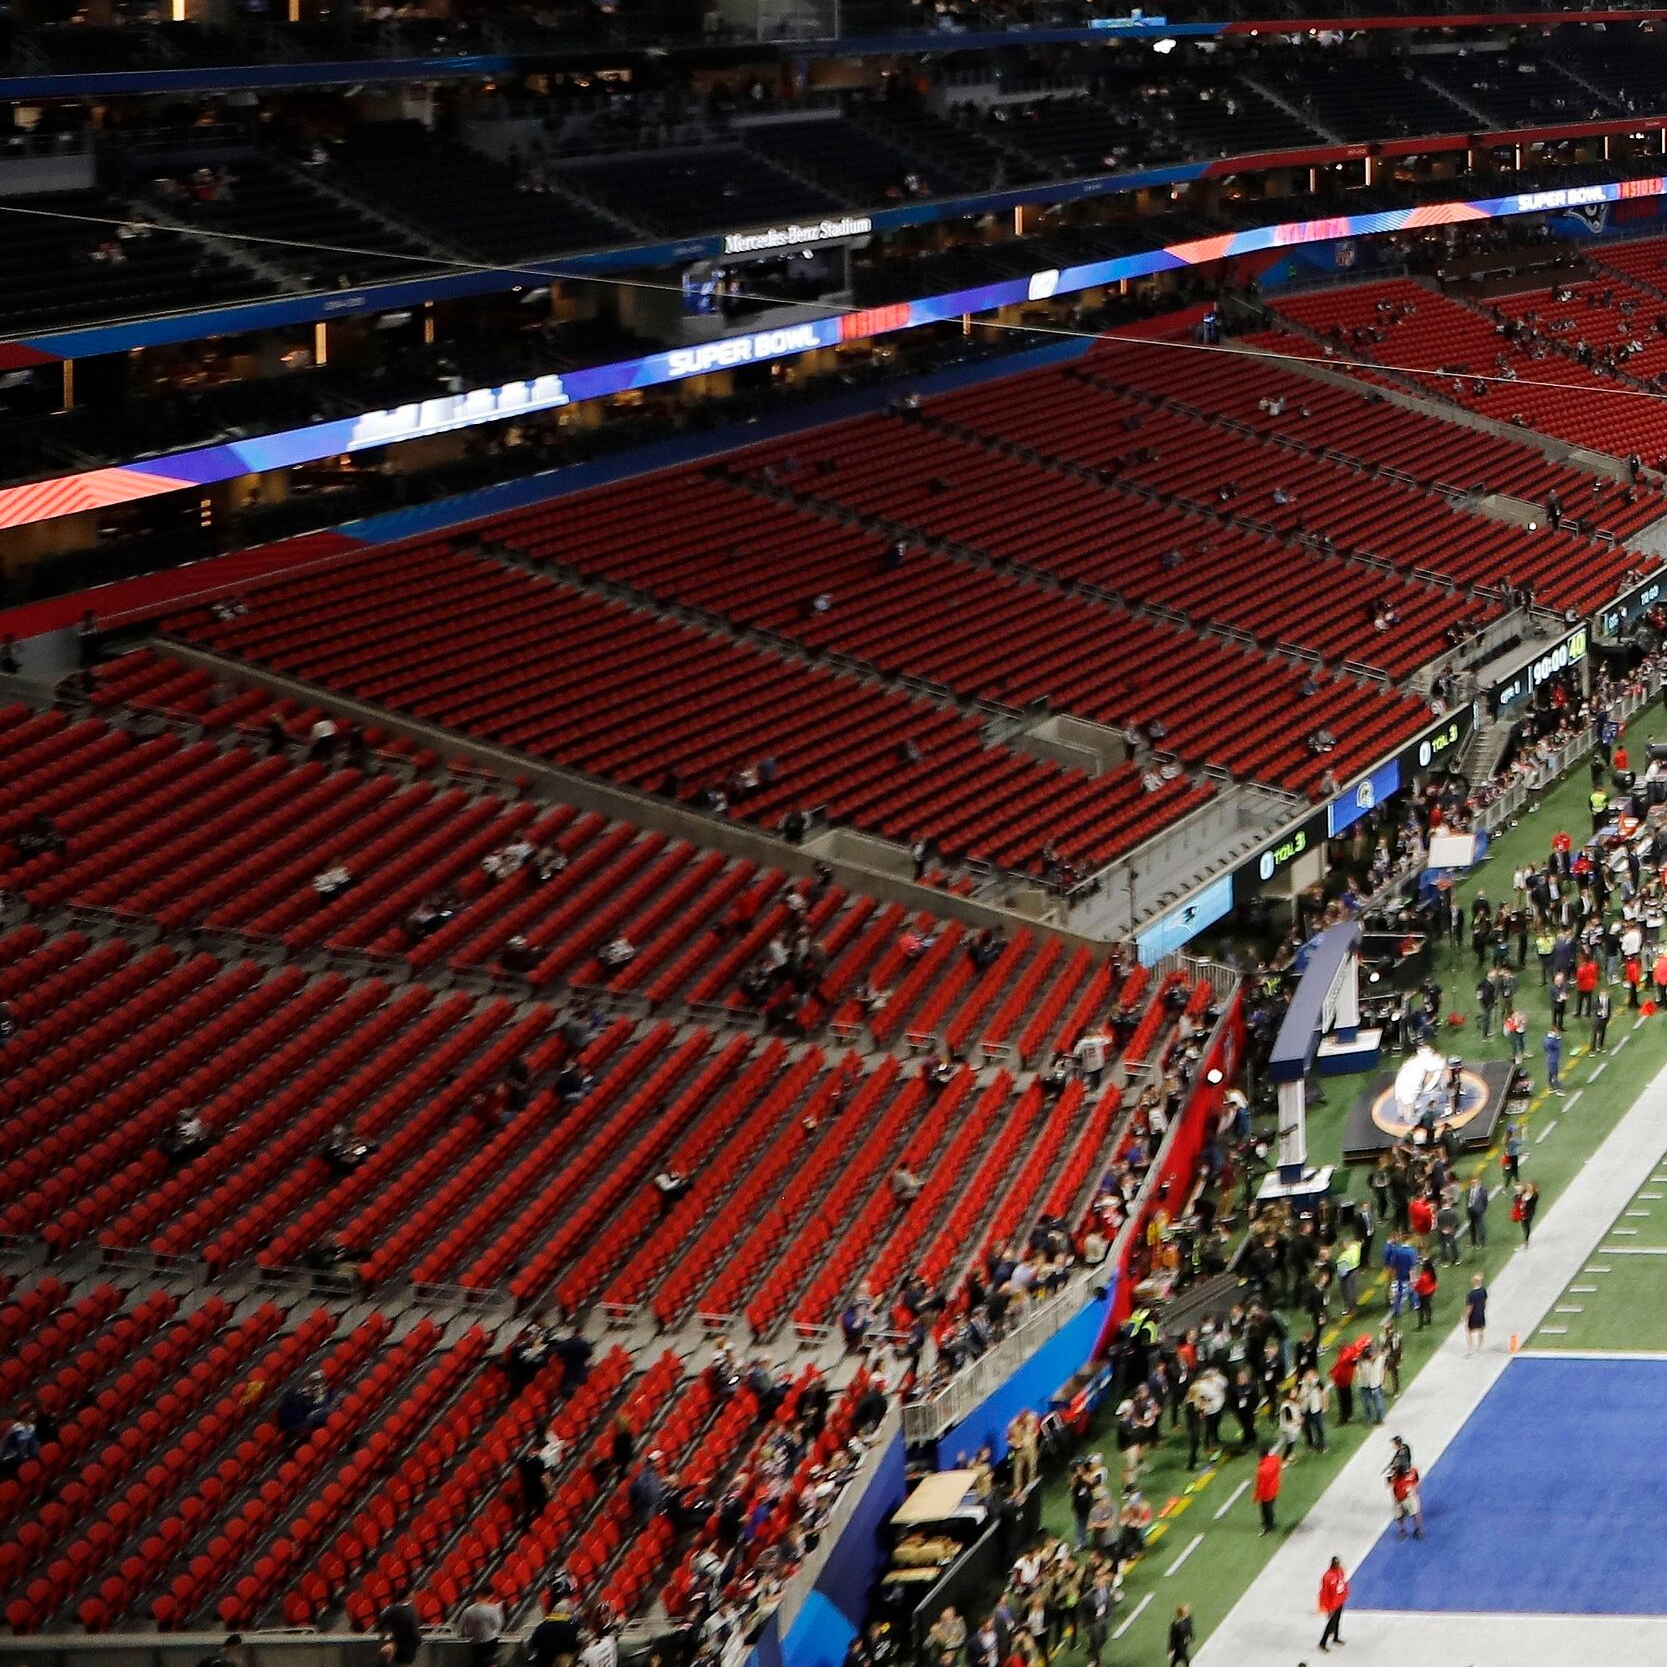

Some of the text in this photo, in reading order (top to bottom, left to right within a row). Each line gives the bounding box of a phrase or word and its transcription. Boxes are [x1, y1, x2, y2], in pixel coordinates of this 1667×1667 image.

[1518, 191, 1565, 212] SUPER
[1567, 187, 1607, 205] BOWL
[724, 217, 871, 255] Mercedes-Benz Stadium
[668, 338, 753, 377] SUPER
[755, 324, 820, 359] BOWL
[1533, 631, 1586, 686] 90:00 40
[1419, 740, 1432, 767] 0
[1449, 724, 1459, 743] 3
[1259, 850, 1275, 880] 0
[1295, 831, 1306, 852] 3
